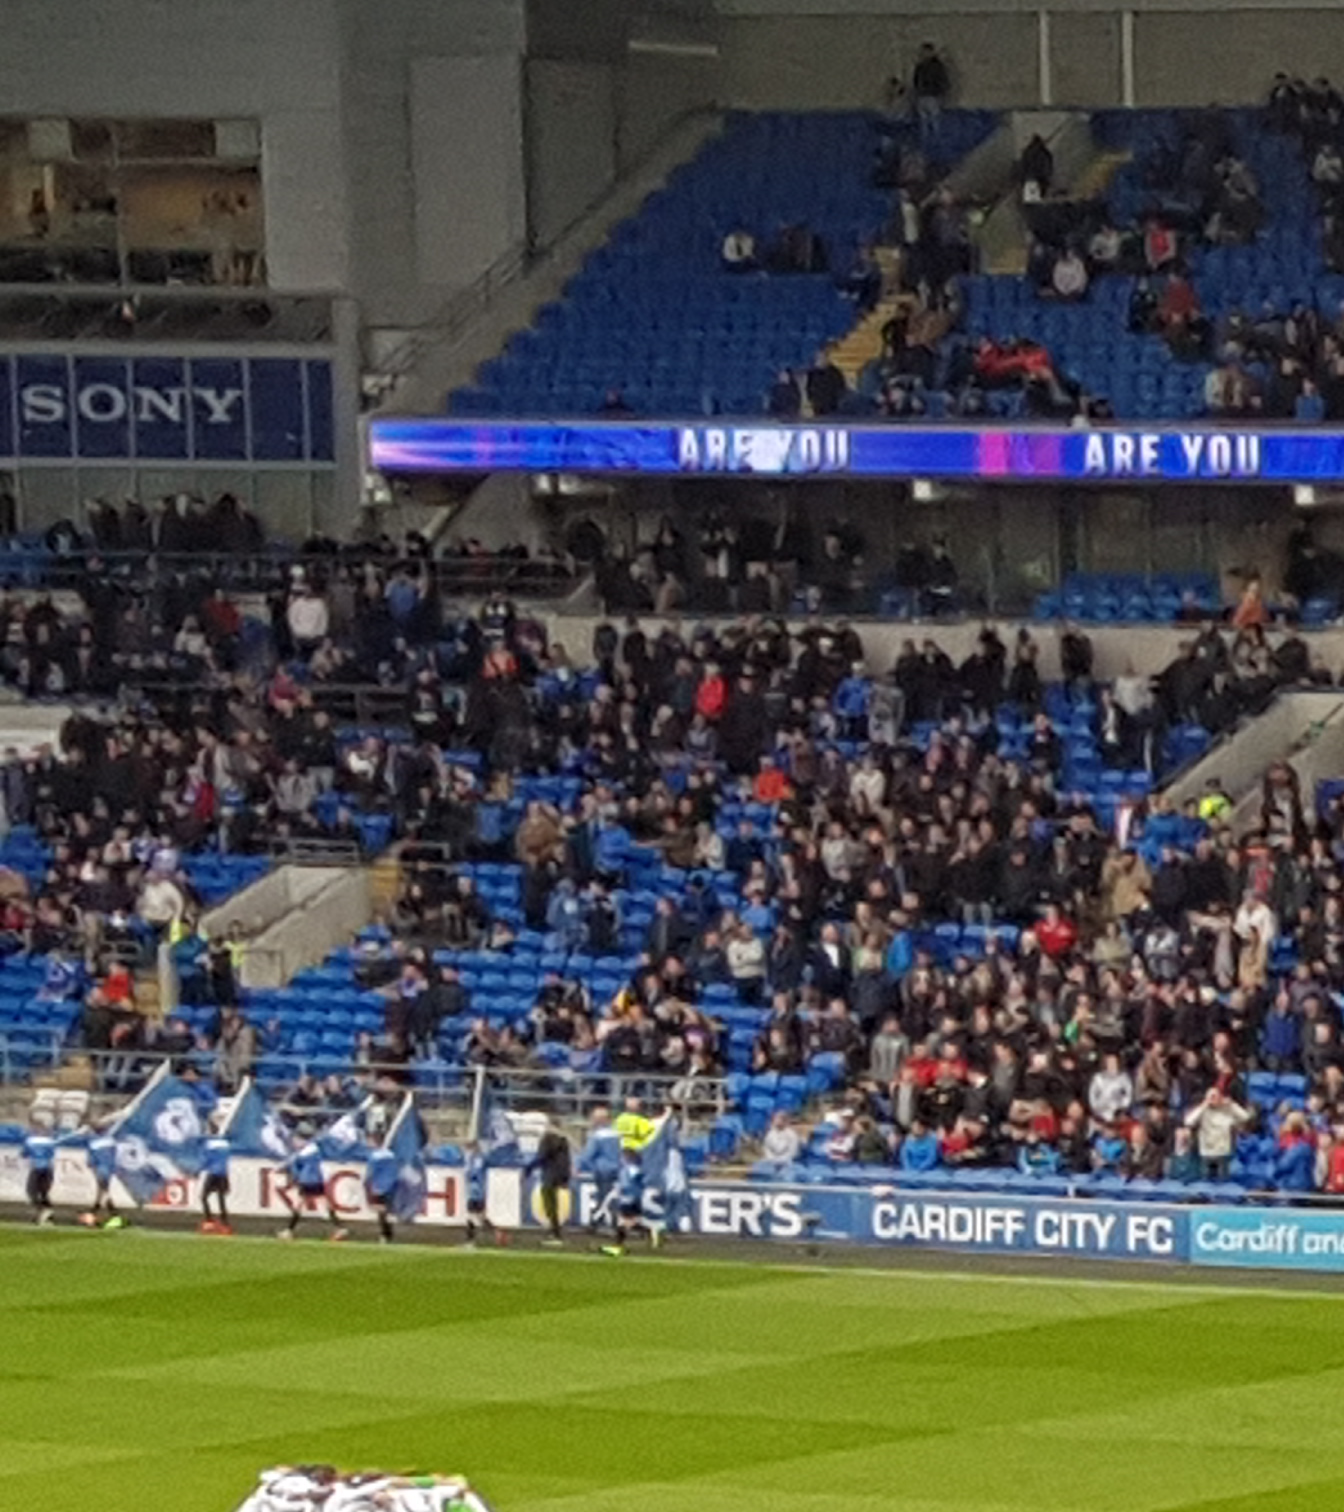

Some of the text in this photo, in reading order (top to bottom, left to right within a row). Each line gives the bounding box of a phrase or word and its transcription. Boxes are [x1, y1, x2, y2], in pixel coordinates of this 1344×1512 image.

[22, 384, 242, 423] SONY
[679, 430, 850, 471] ARE YOU
[1084, 434, 1260, 474] ARE YOU
[872, 1203, 1173, 1252] CARDIFF CITY FC
[1197, 1222, 1298, 1252] Cardiff
